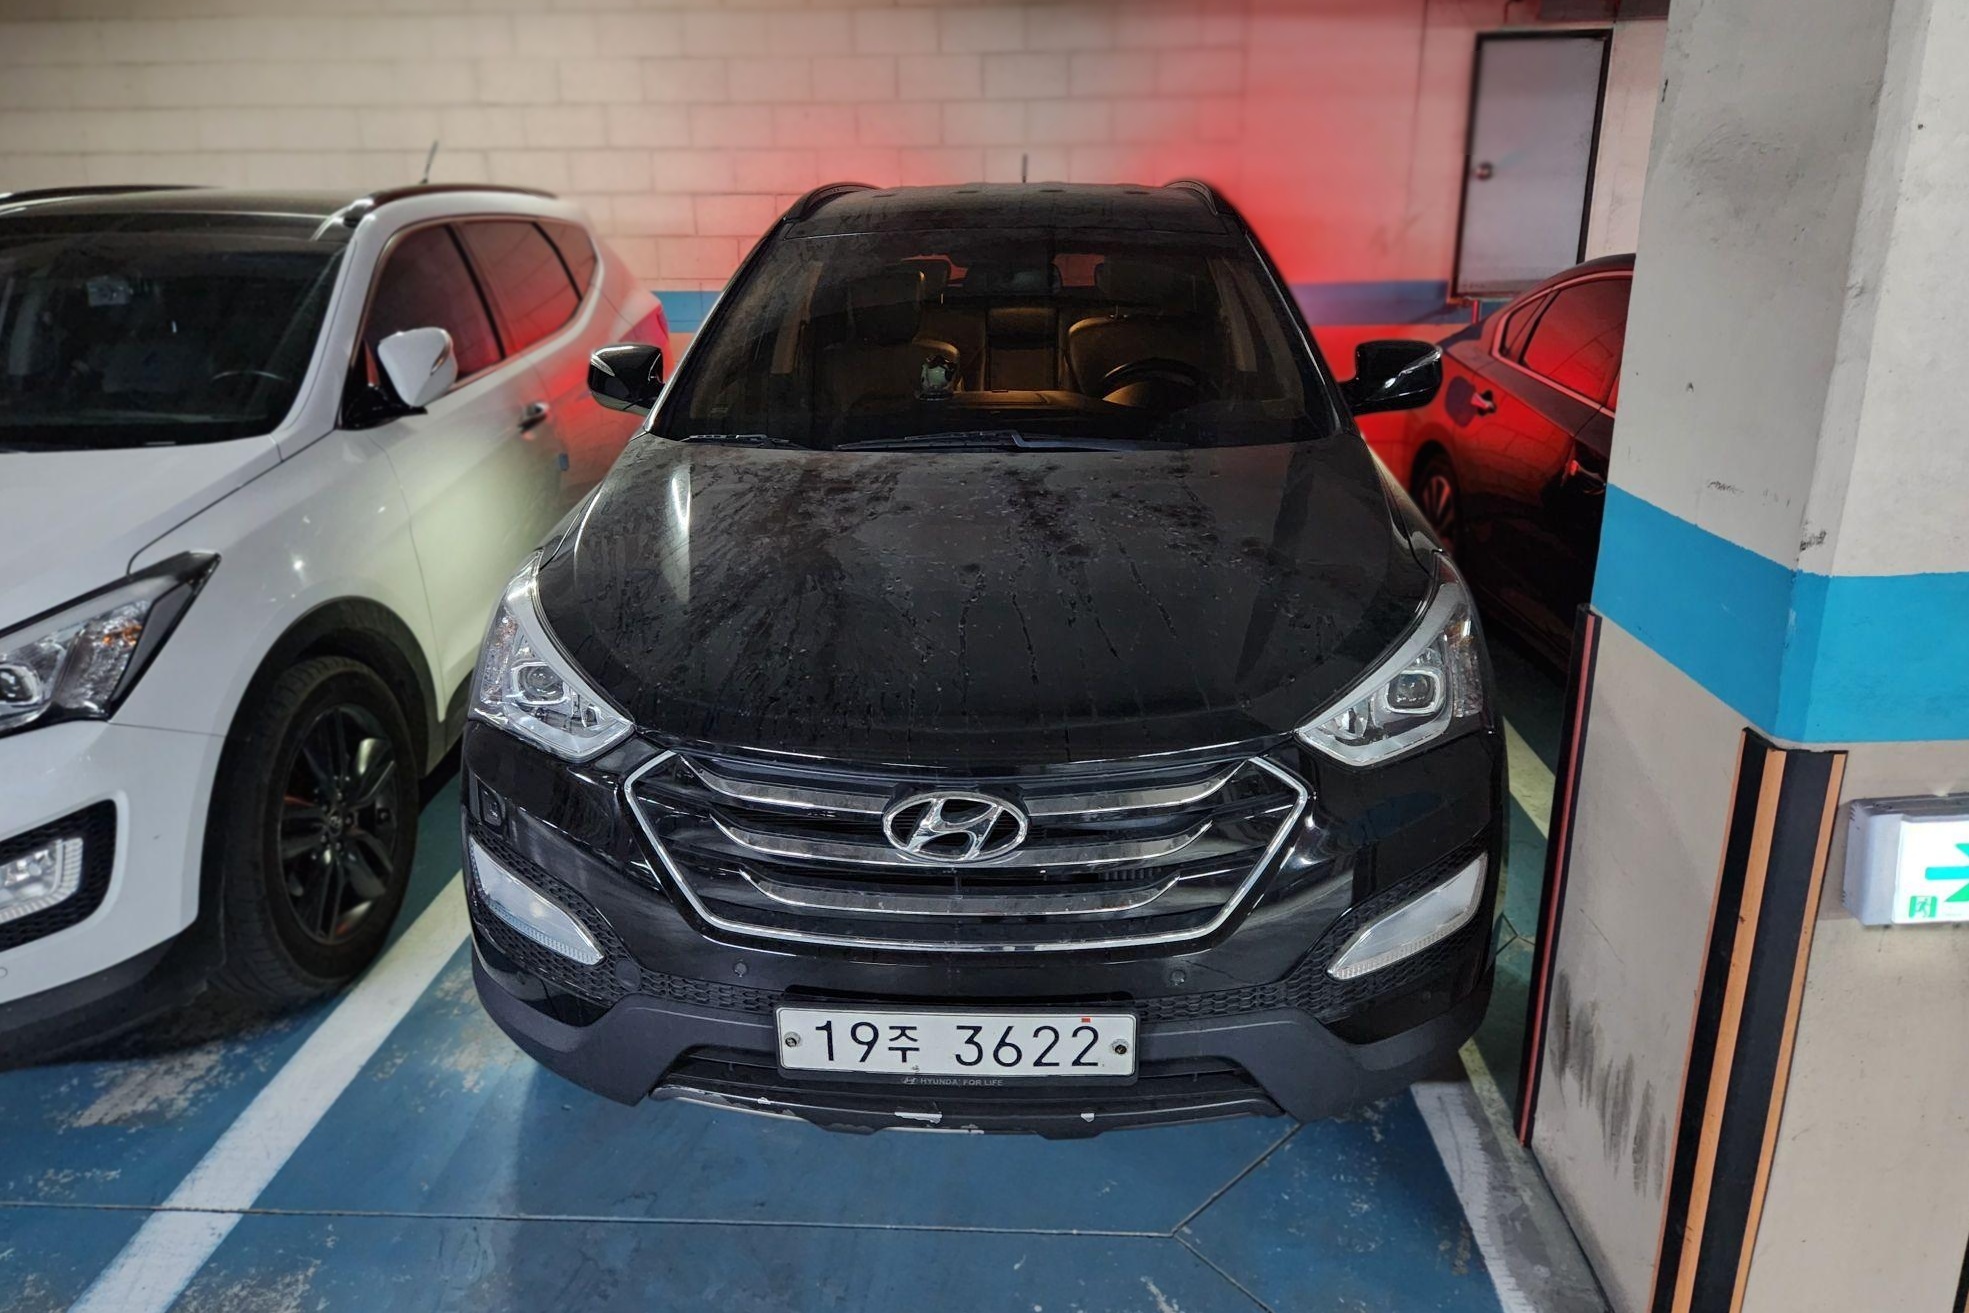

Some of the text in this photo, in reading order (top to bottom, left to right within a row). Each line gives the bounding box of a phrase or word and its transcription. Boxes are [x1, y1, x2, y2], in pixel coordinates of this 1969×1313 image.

[815, 1020, 1099, 1067] 19주 3622
[963, 1078, 981, 1087] FOR
[984, 1079, 1004, 1087] LIFE
